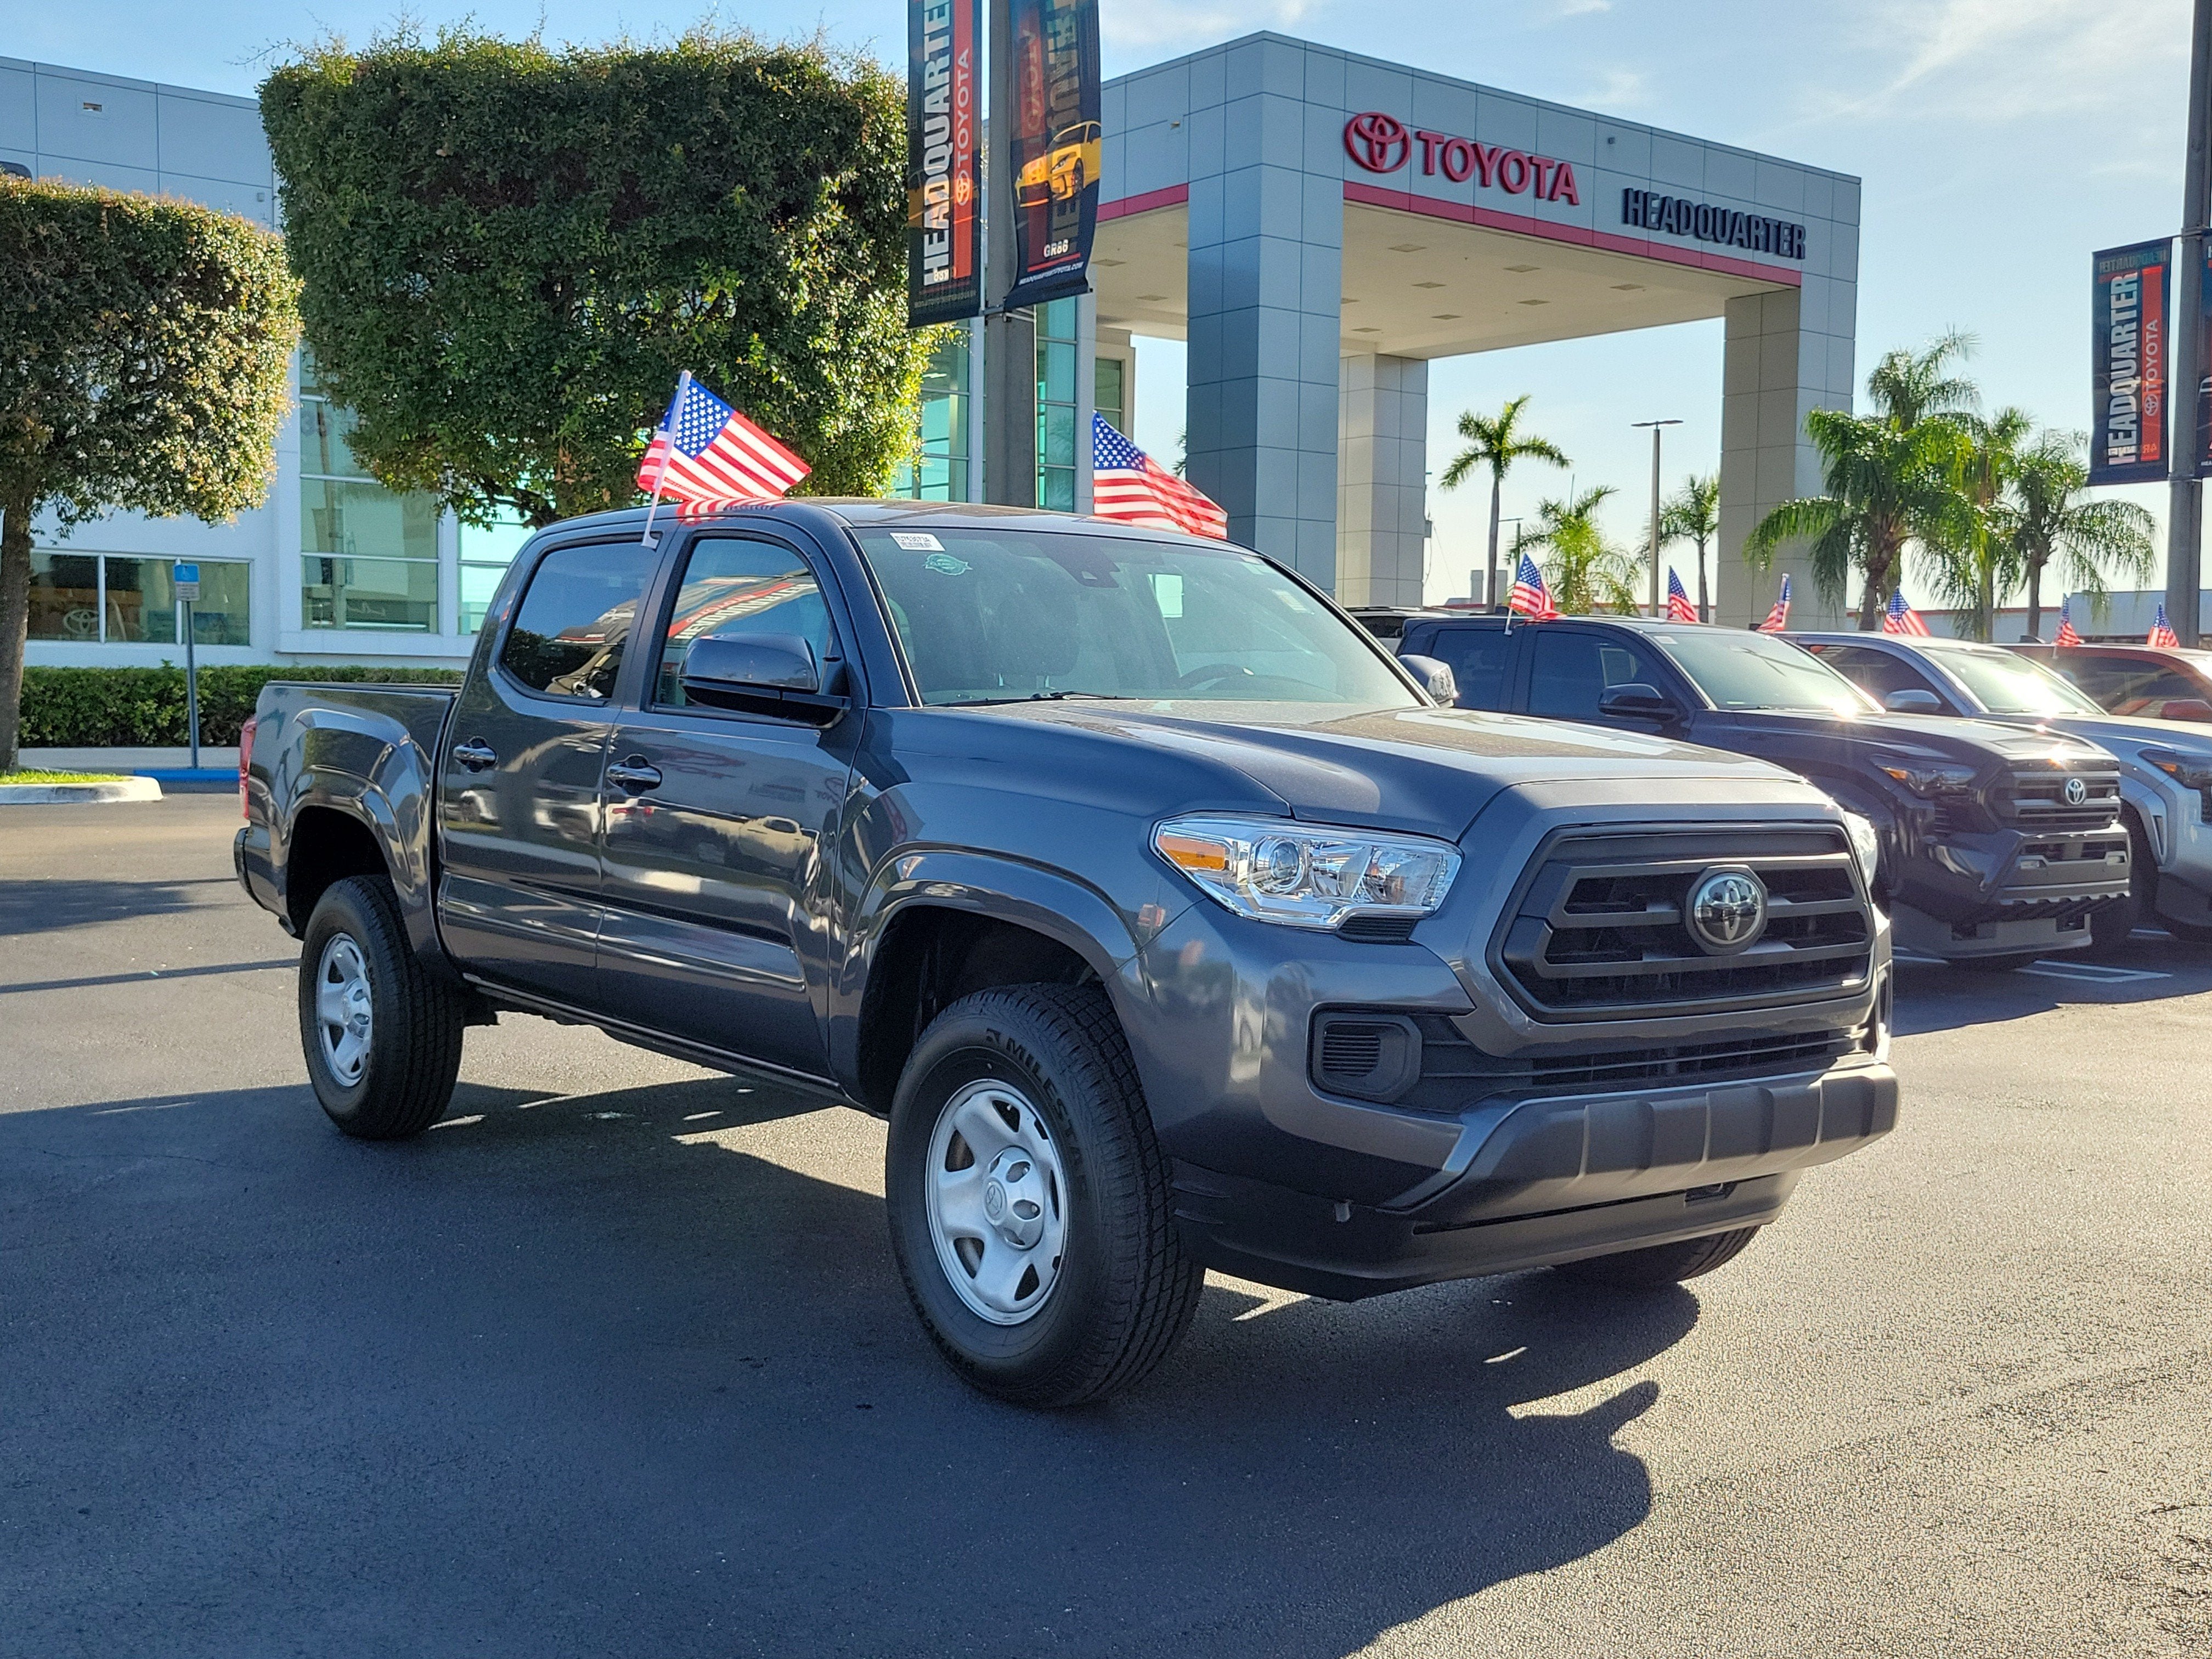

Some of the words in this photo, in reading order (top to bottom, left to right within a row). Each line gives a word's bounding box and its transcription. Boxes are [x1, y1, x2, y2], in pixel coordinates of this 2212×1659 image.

[957, 48, 969, 166] TOYOTA
[1415, 131, 1579, 205] TOYOTA
[1043, 239, 1069, 258] GR86
[1622, 188, 1806, 259] HEADQUARTER
[2108, 272, 2141, 465] HEADQUARTER
[2145, 319, 2159, 392] TOYOTA
